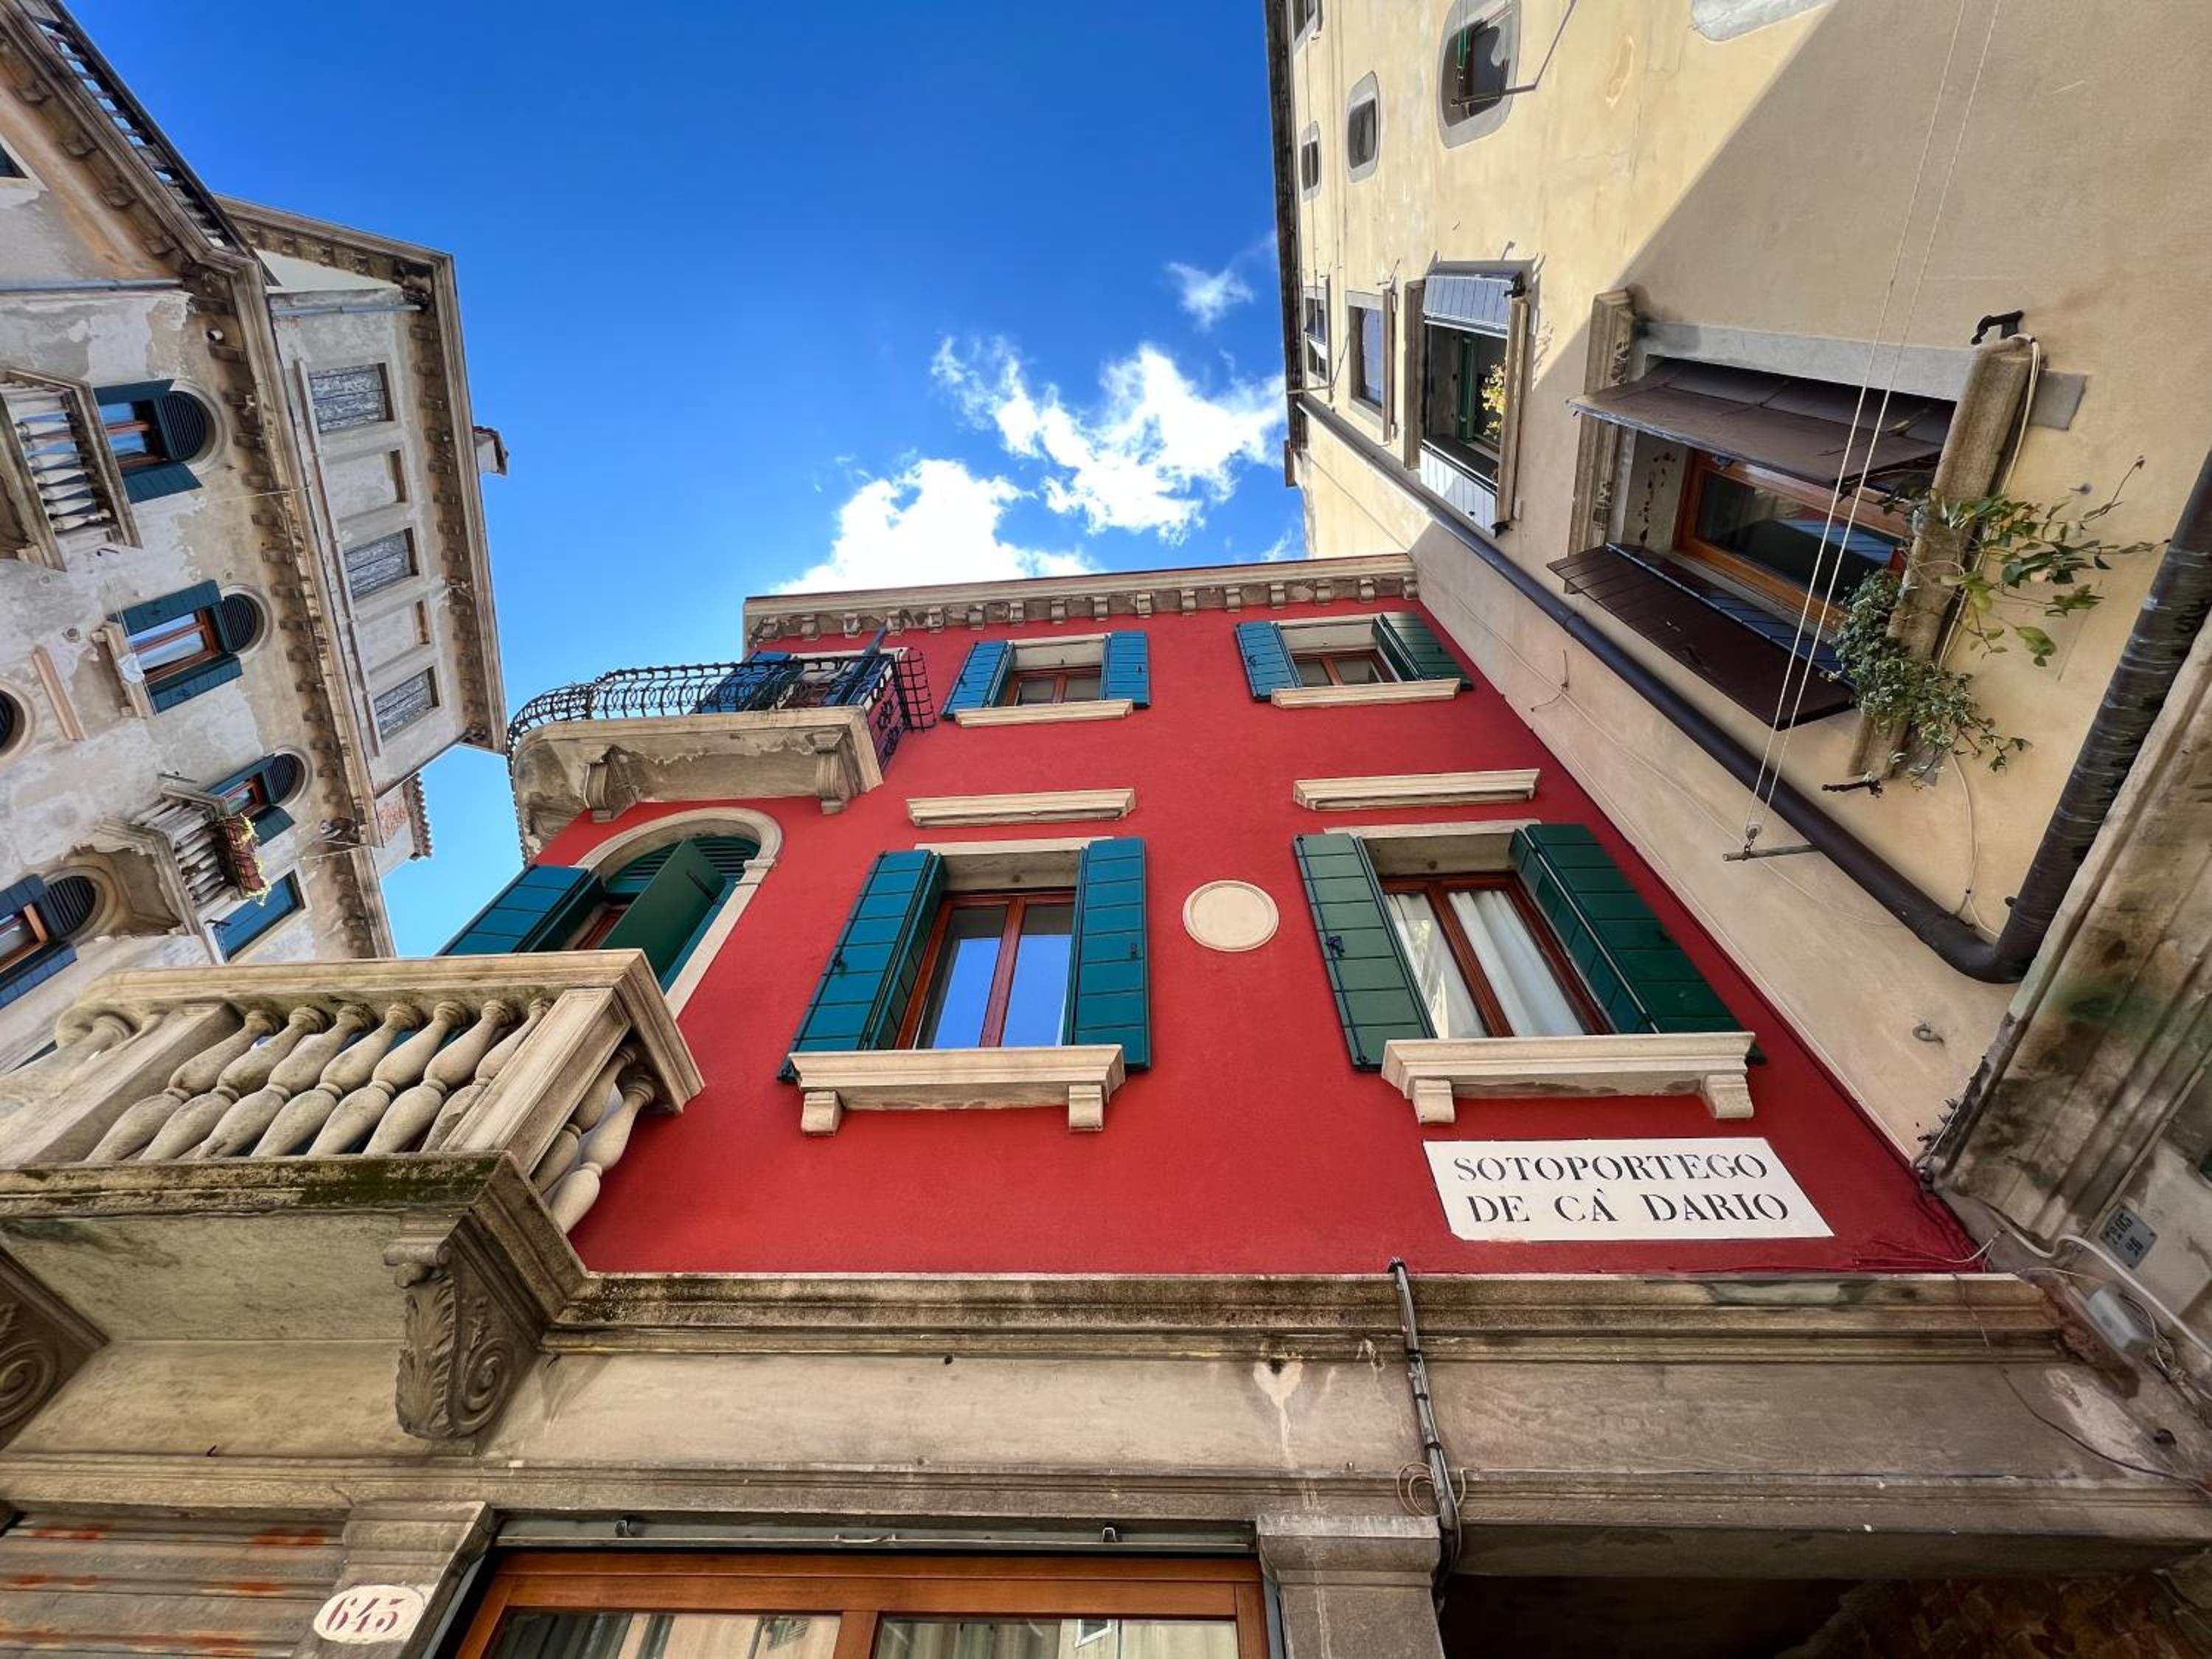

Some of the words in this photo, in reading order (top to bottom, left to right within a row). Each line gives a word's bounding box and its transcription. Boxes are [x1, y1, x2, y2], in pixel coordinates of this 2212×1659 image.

[1453, 1154, 1767, 1181] SOTOPORTEGO
[1467, 1195, 1531, 1222] DE
[1554, 1188, 1618, 1222] CÀ
[1639, 1194, 1789, 1222] DARIO
